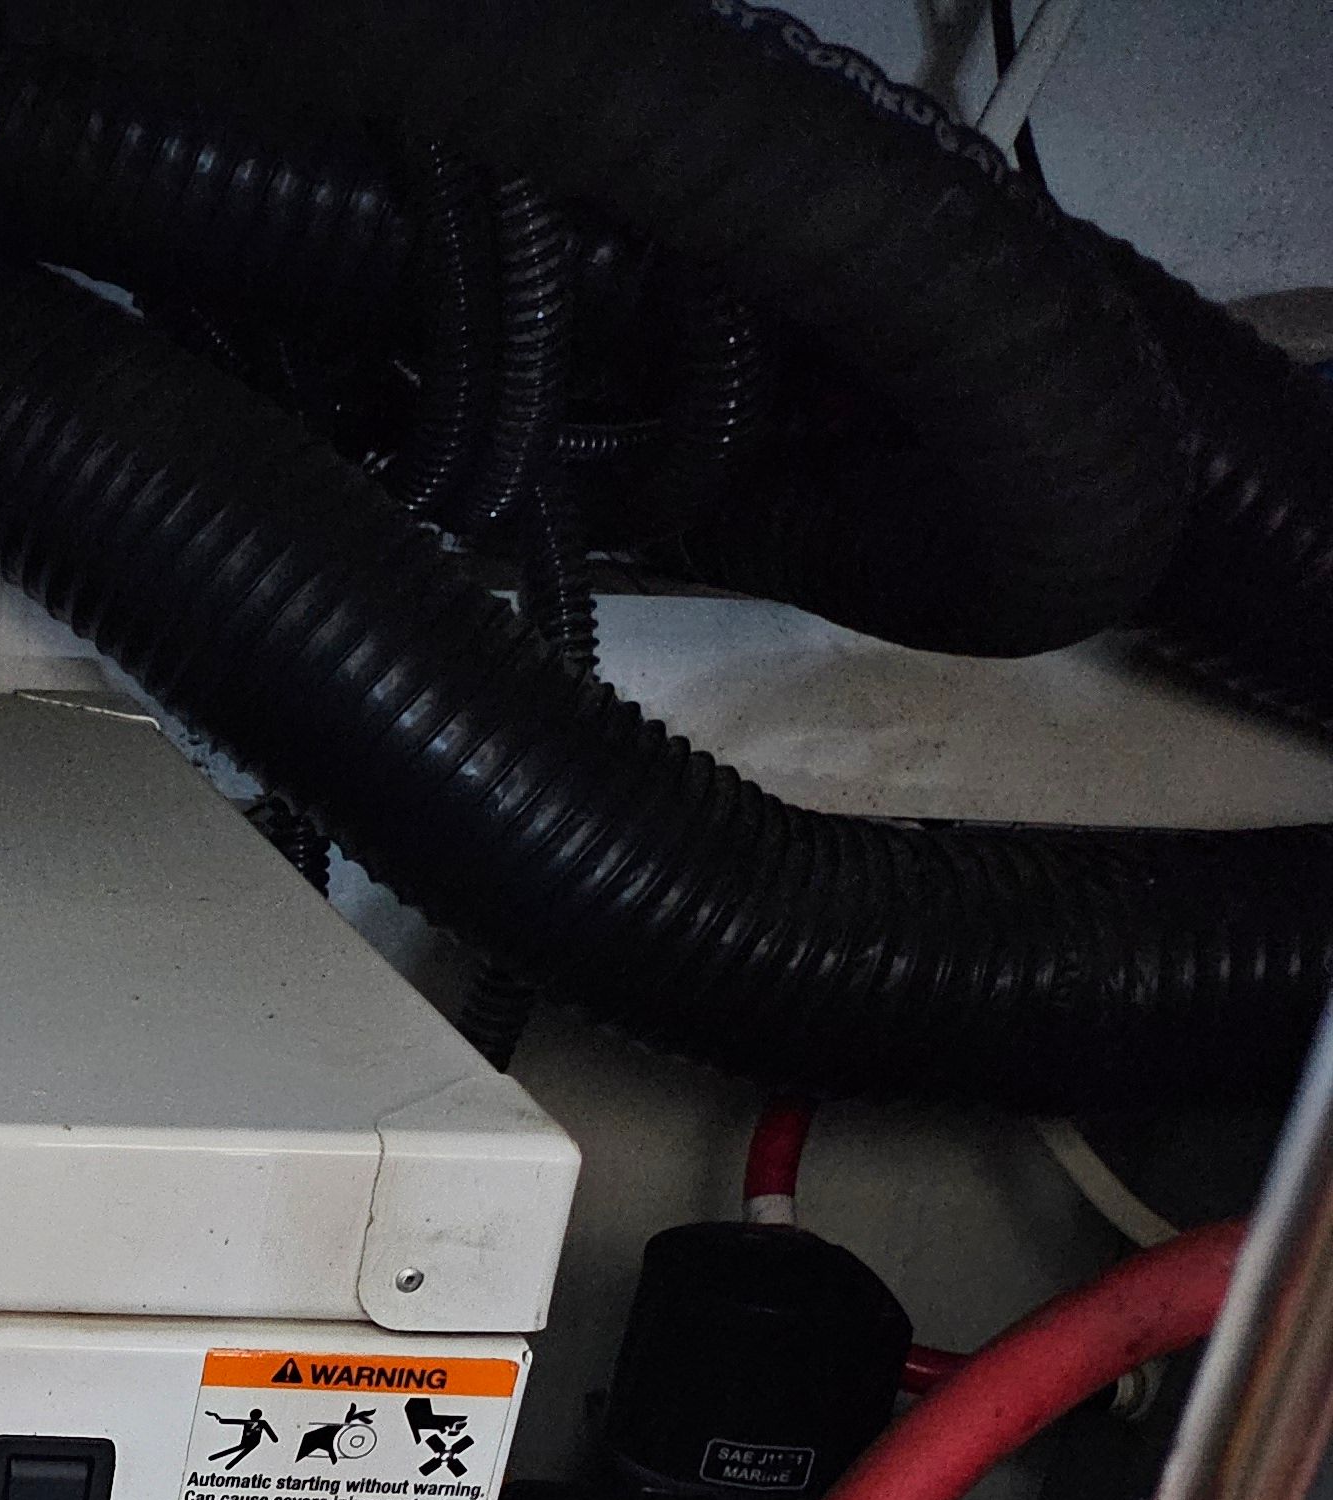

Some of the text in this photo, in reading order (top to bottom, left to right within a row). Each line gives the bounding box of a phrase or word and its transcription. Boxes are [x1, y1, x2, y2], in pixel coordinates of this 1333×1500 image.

[310, 1362, 447, 1390] WARNING
[717, 1447, 754, 1464] SAE
[186, 1470, 485, 1500] Automatic starting without warning.
